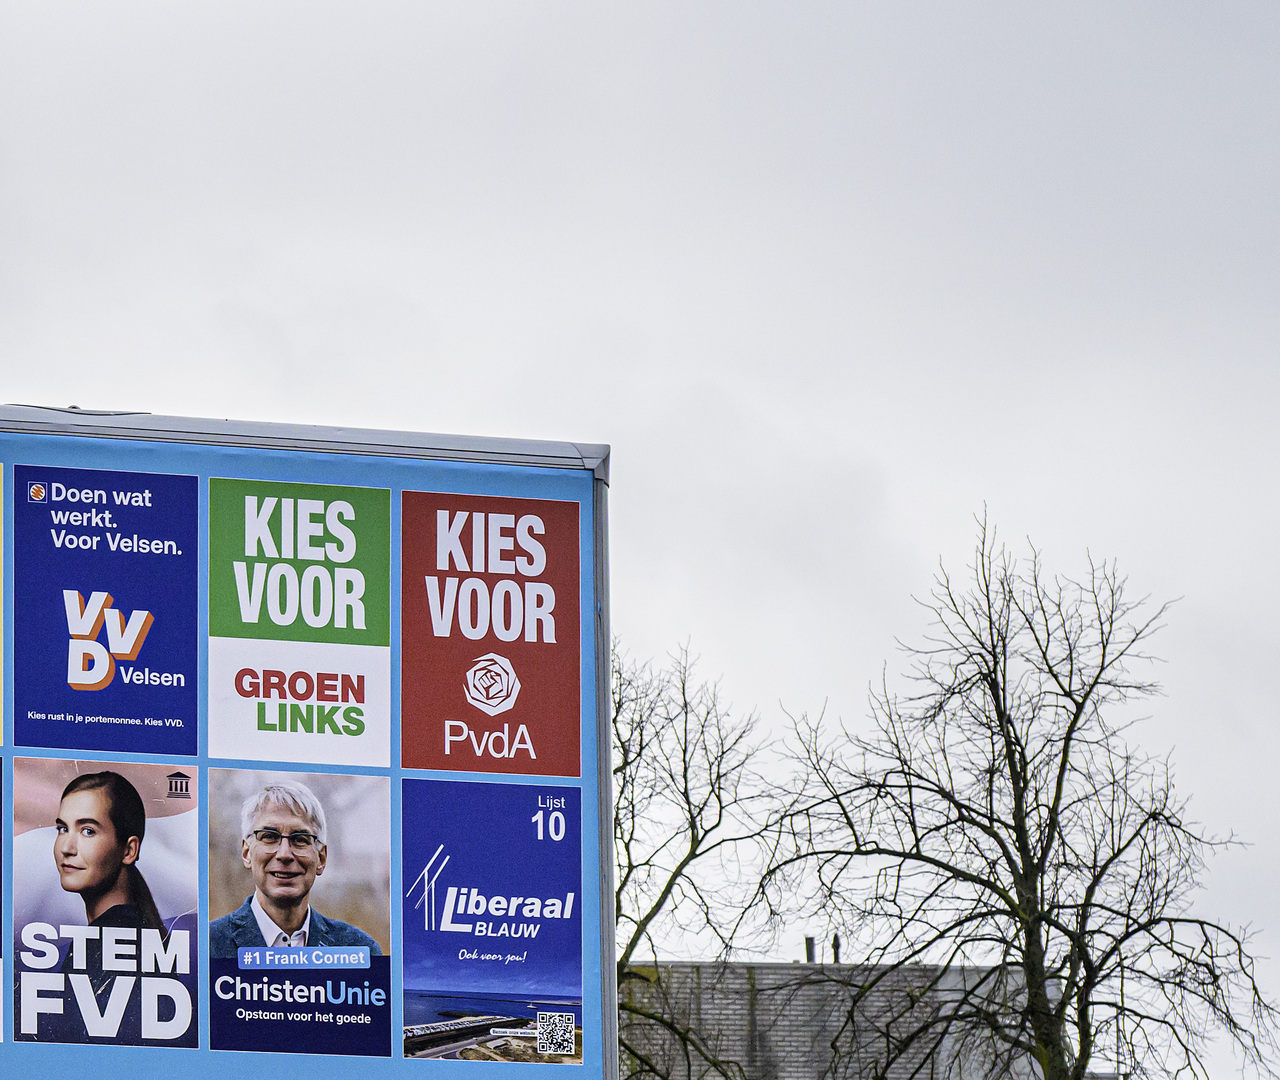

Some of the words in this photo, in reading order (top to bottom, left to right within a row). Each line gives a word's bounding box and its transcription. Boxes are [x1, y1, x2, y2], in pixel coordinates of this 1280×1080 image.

[51, 482, 107, 504] Doen
[112, 489, 152, 507] wat
[50, 508, 117, 528] werkt.
[243, 495, 357, 563] KIES
[50, 529, 100, 550] Voor
[105, 532, 182, 555] Velsen.
[436, 509, 547, 577] KIES
[233, 560, 366, 630] VOOR
[425, 574, 557, 644] VOOR
[119, 666, 185, 687] Velsen
[234, 667, 365, 704] GROEN
[27, 710, 46, 720] Kies
[47, 712, 64, 721] rust
[66, 712, 74, 721] in
[75, 713, 83, 724] je
[85, 714, 143, 726] portemonnee.
[144, 717, 163, 727] Kies
[164, 718, 184, 728] VVD.
[256, 701, 365, 736] LINKS
[443, 720, 537, 760] PvdA
[538, 795, 566, 811] Lijst
[531, 810, 566, 841] 10
[439, 887, 575, 933] Liberaal
[474, 921, 541, 938] BLAUW
[20, 922, 191, 975] STEM
[243, 951, 261, 965] #1
[265, 951, 308, 965] Frank
[312, 950, 365, 965] Cornet
[458, 948, 478, 960] Ook
[480, 952, 503, 961] voor
[505, 951, 527, 965] jou!
[20, 970, 192, 1040] FVD
[214, 975, 386, 1006] ChristenUnie
[235, 1008, 284, 1021] Opstaan
[287, 1011, 312, 1022] voor
[315, 1011, 334, 1023] het
[336, 1013, 371, 1025] goede
